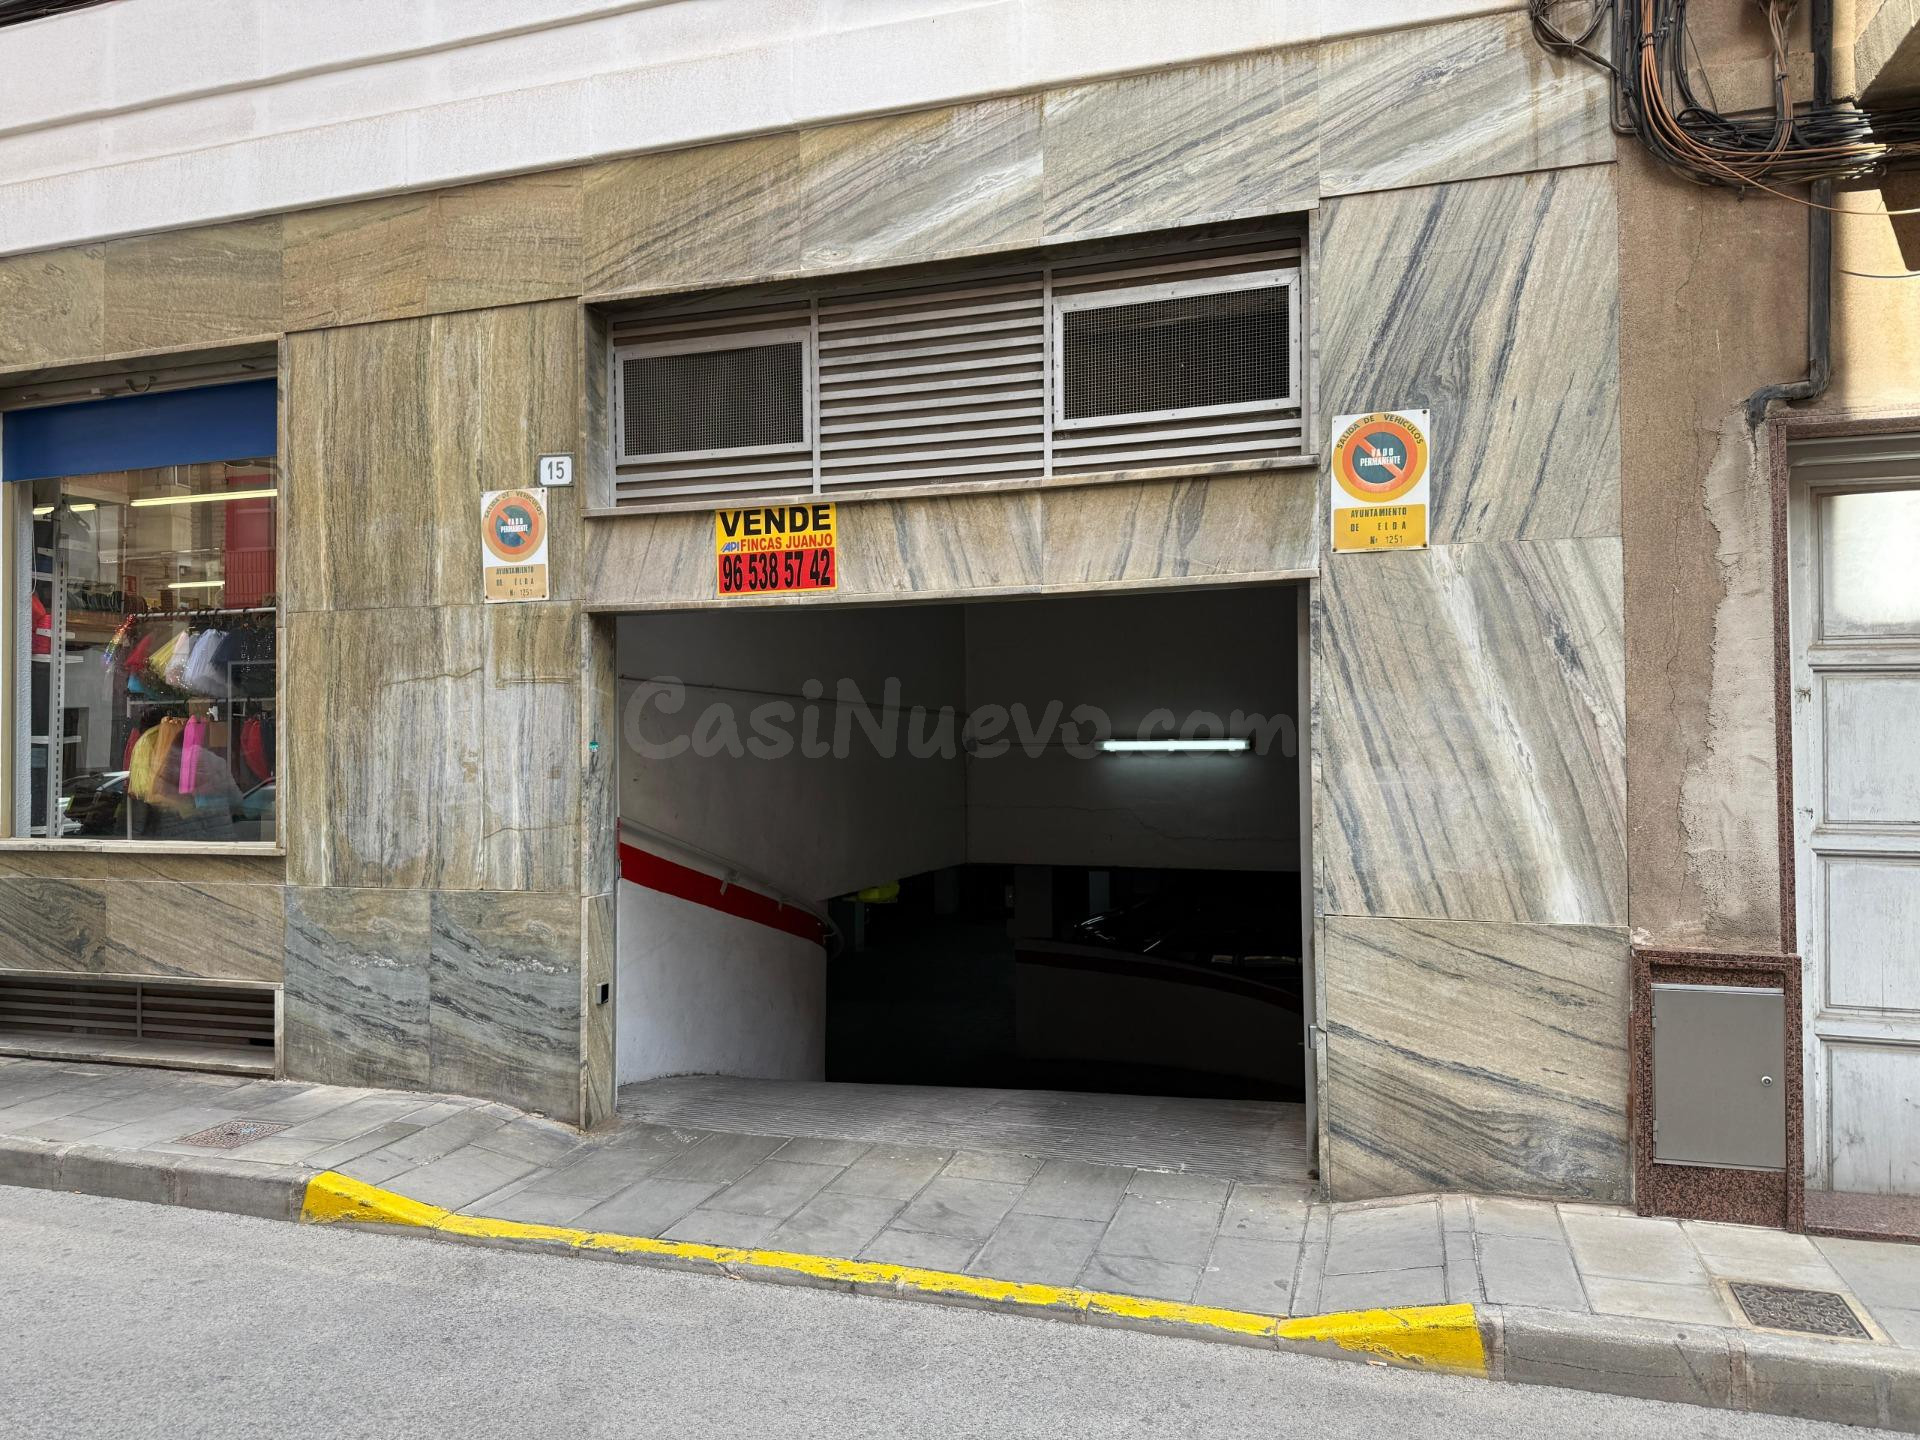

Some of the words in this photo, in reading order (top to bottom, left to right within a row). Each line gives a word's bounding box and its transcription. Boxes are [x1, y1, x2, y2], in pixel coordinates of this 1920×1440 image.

[1336, 423, 1361, 450] SALIDA
[1363, 416, 1376, 425] DE
[1383, 413, 1424, 445] VEHICULOS
[1371, 447, 1394, 457] VADO
[1359, 455, 1401, 467] PERMANENTE
[547, 460, 565, 480] 15
[1350, 507, 1407, 519] AYUNTAMIENTO
[719, 504, 832, 538] VENDE
[1350, 523, 1360, 533] DE
[1377, 521, 1407, 532] ELDA
[500, 524, 529, 534] PERMANENTE
[740, 536, 782, 552] FINCAS
[785, 532, 833, 549] JUANJO
[1385, 535, 1403, 544] 1251
[722, 554, 743, 592] 96
[748, 552, 779, 590] 538
[784, 550, 804, 588] 57
[809, 548, 831, 586] 42
